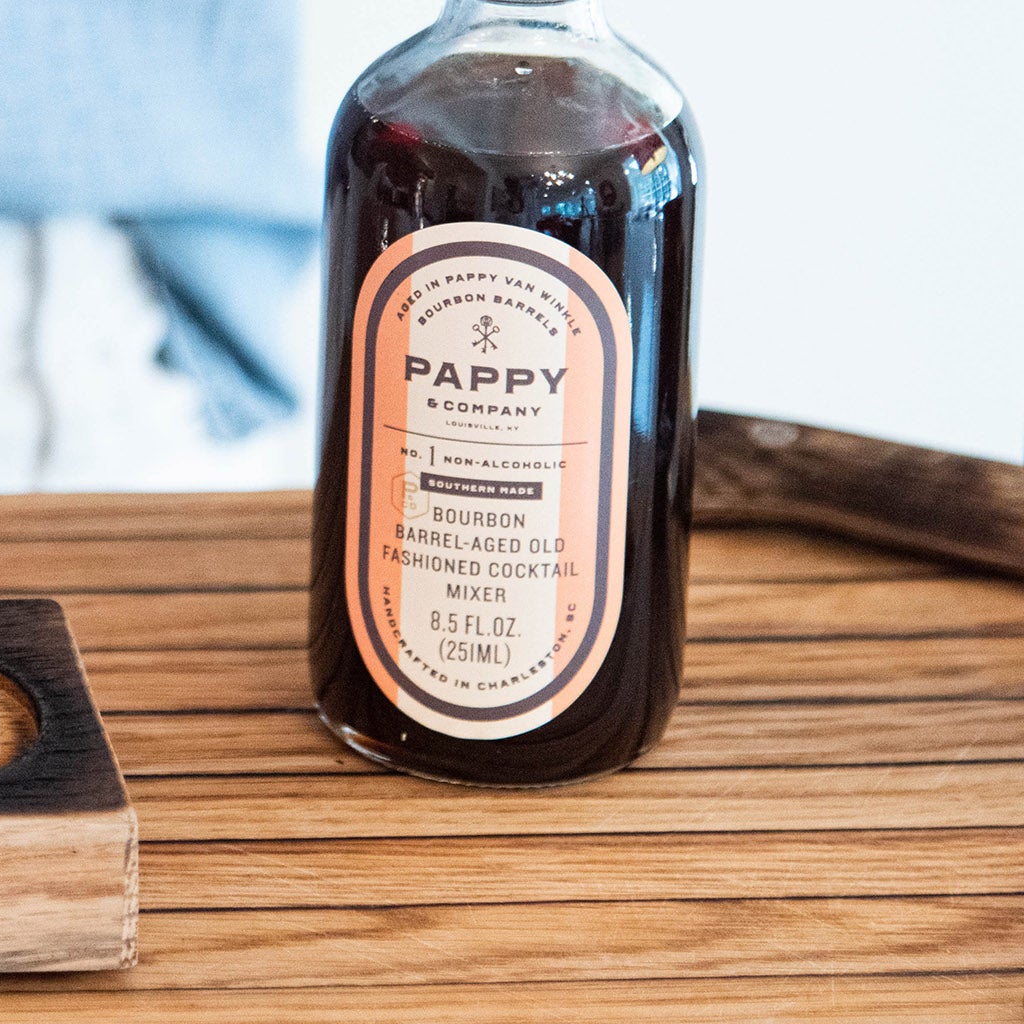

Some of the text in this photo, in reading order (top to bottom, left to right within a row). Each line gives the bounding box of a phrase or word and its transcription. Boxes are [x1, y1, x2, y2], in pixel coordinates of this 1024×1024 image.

[396, 273, 582, 337] AGED IN PAPPY VAN WINKLE
[418, 293, 558, 337] BOURBON BARRELS
[404, 354, 569, 394] PAPPY
[400, 446, 567, 470] NO. 1 NON-ALCOHOLIC
[427, 479, 535, 496] SOUTHERN MADE
[433, 506, 526, 529] BOURBON
[395, 524, 565, 554] BARREL-AGED OLD
[382, 544, 579, 578] FASHIONED COCKTAIL
[446, 583, 506, 603] MIXER
[430, 610, 458, 634] 8.5
[383, 586, 449, 683] HANDCRAFTED
[454, 679, 470, 690] IN
